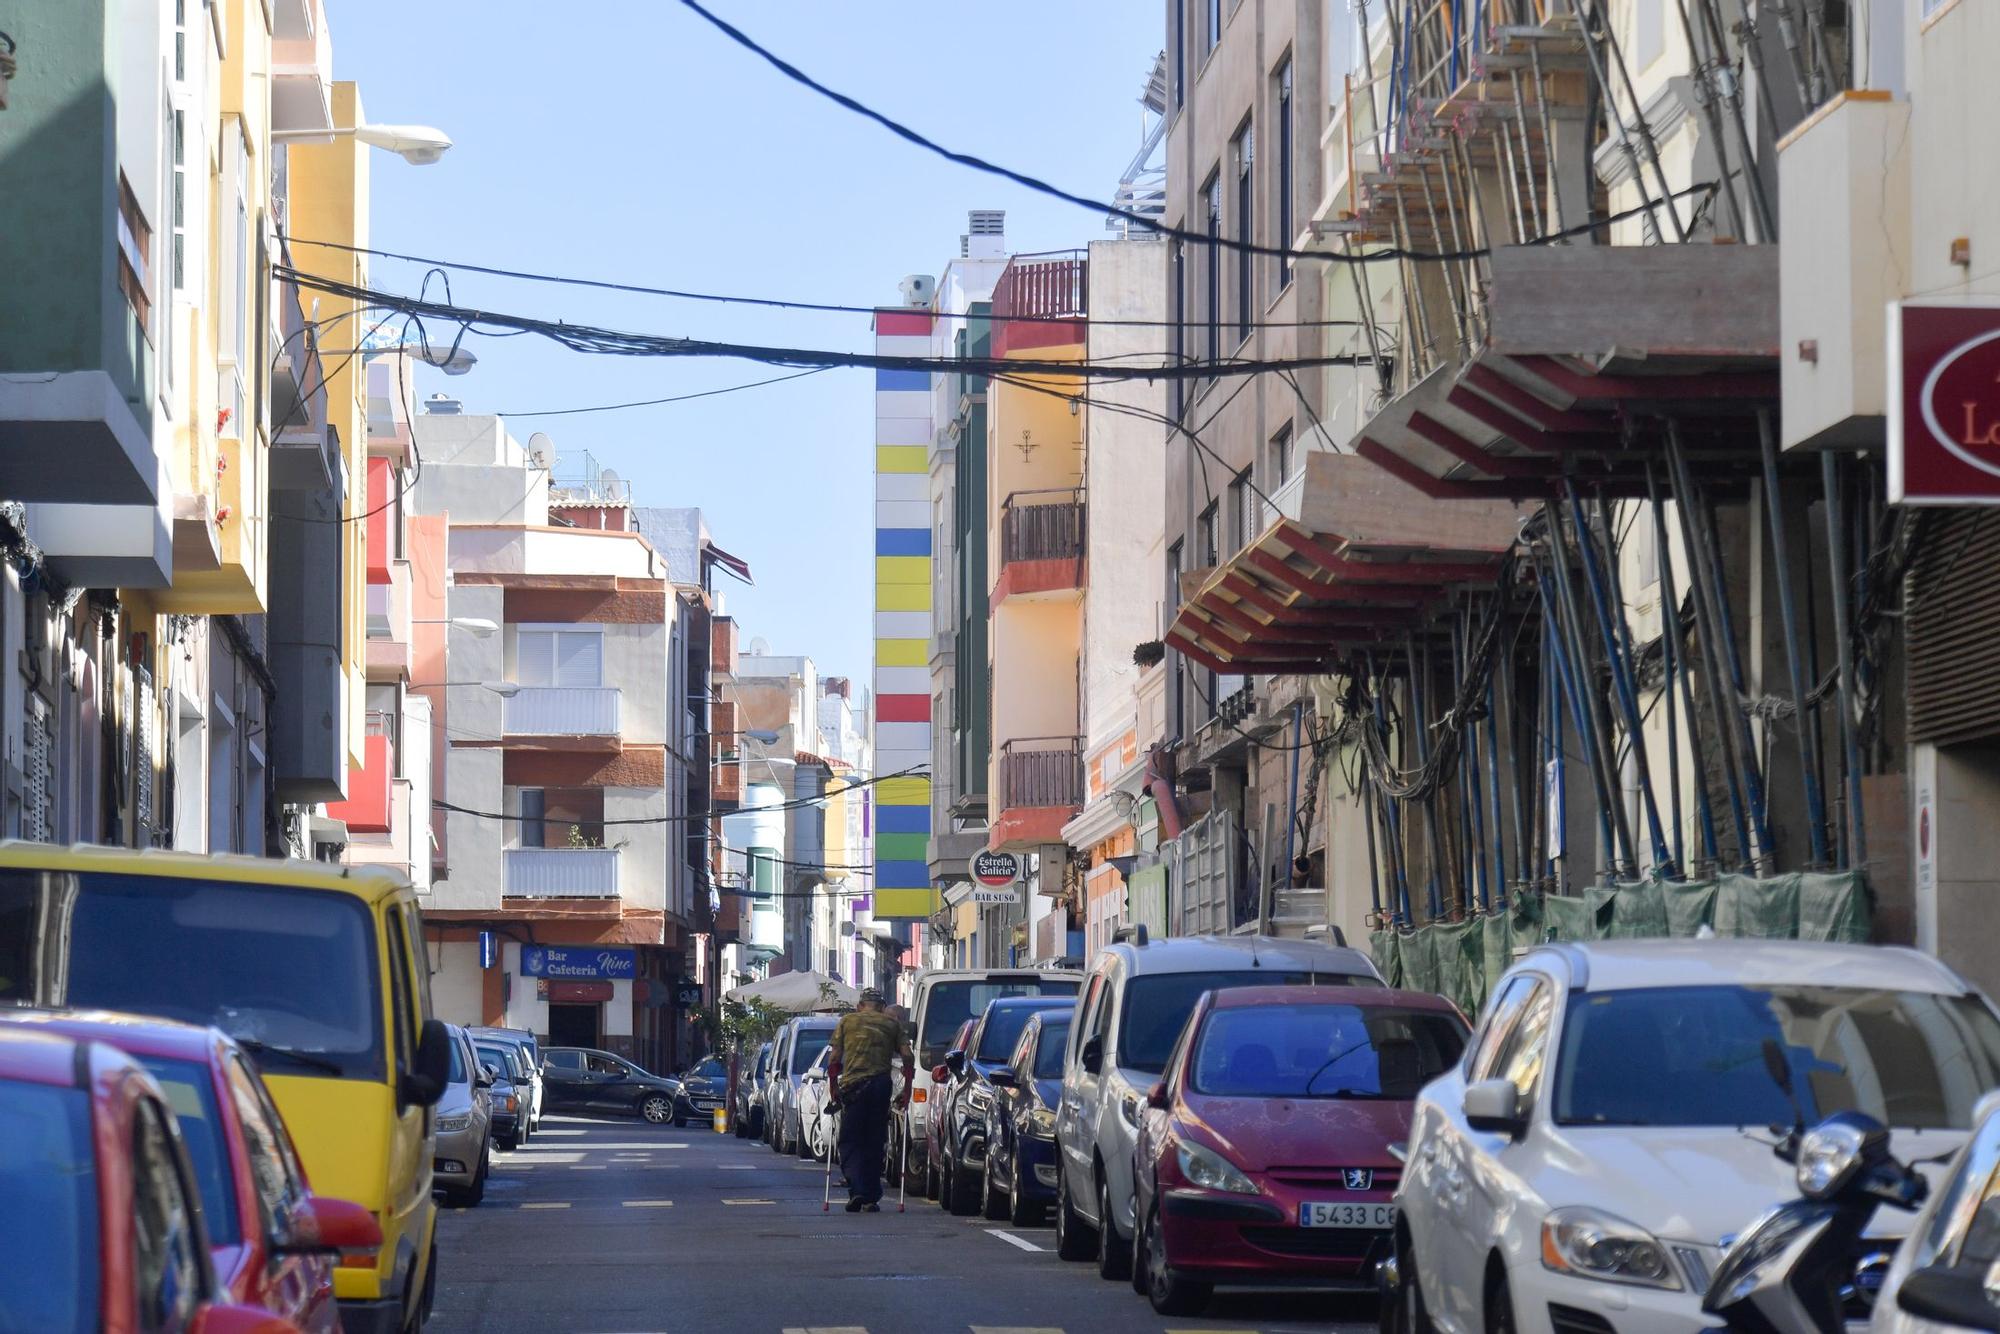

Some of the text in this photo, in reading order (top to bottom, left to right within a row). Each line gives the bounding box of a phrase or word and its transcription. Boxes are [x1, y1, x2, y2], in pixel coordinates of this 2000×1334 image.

[979, 856, 1012, 867] Estrella
[980, 866, 1011, 876] Galicia
[975, 893, 1015, 902] BAR SUSO
[547, 950, 567, 961] Bar
[547, 964, 597, 976] Cafeteria
[1315, 1206, 1366, 1225] 5433
